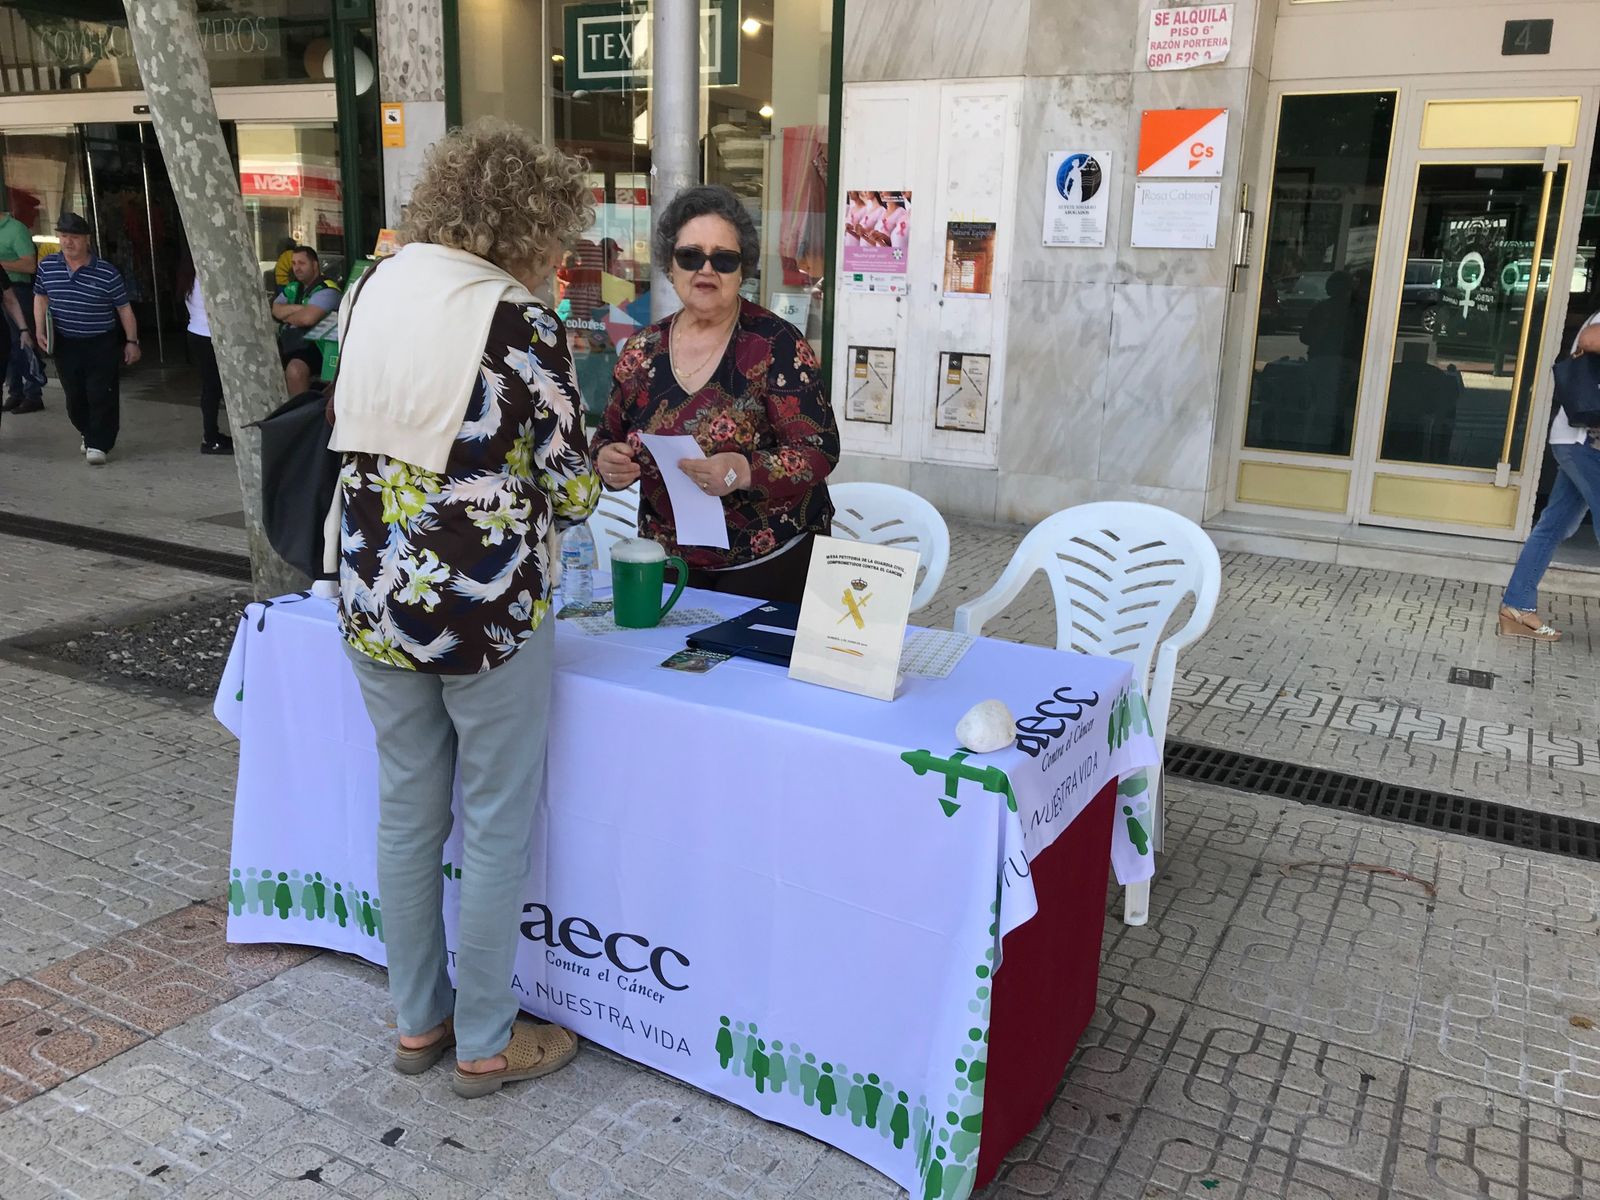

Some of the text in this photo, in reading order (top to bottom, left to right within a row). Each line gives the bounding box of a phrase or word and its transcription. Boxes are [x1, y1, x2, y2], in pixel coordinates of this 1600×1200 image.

[1154, 7, 1228, 26] SE ALQUILA
[40, 16, 268, 62] COMERCI VEROS
[1170, 27, 1199, 37] PISO
[1514, 22, 1532, 50] 4
[587, 32, 633, 61] TEX
[1148, 53, 1172, 67] 680
[1189, 142, 1214, 158] Cs
[1144, 188, 1210, 201] Rosa Cabrera
[566, 318, 606, 331] colores
[862, 563, 879, 571] CONTRA
[873, 560, 893, 568] GUARDIA
[1015, 686, 1099, 758] aecc
[1041, 717, 1095, 773] Contra el Cáncer
[1030, 774, 1079, 831] NUESTRA
[1078, 750, 1099, 785] VIDA
[519, 902, 690, 992] aecc
[545, 950, 665, 1005] Contra el Cáncer
[536, 981, 635, 1034] NUESTRA
[639, 1020, 691, 1057] VIDA
